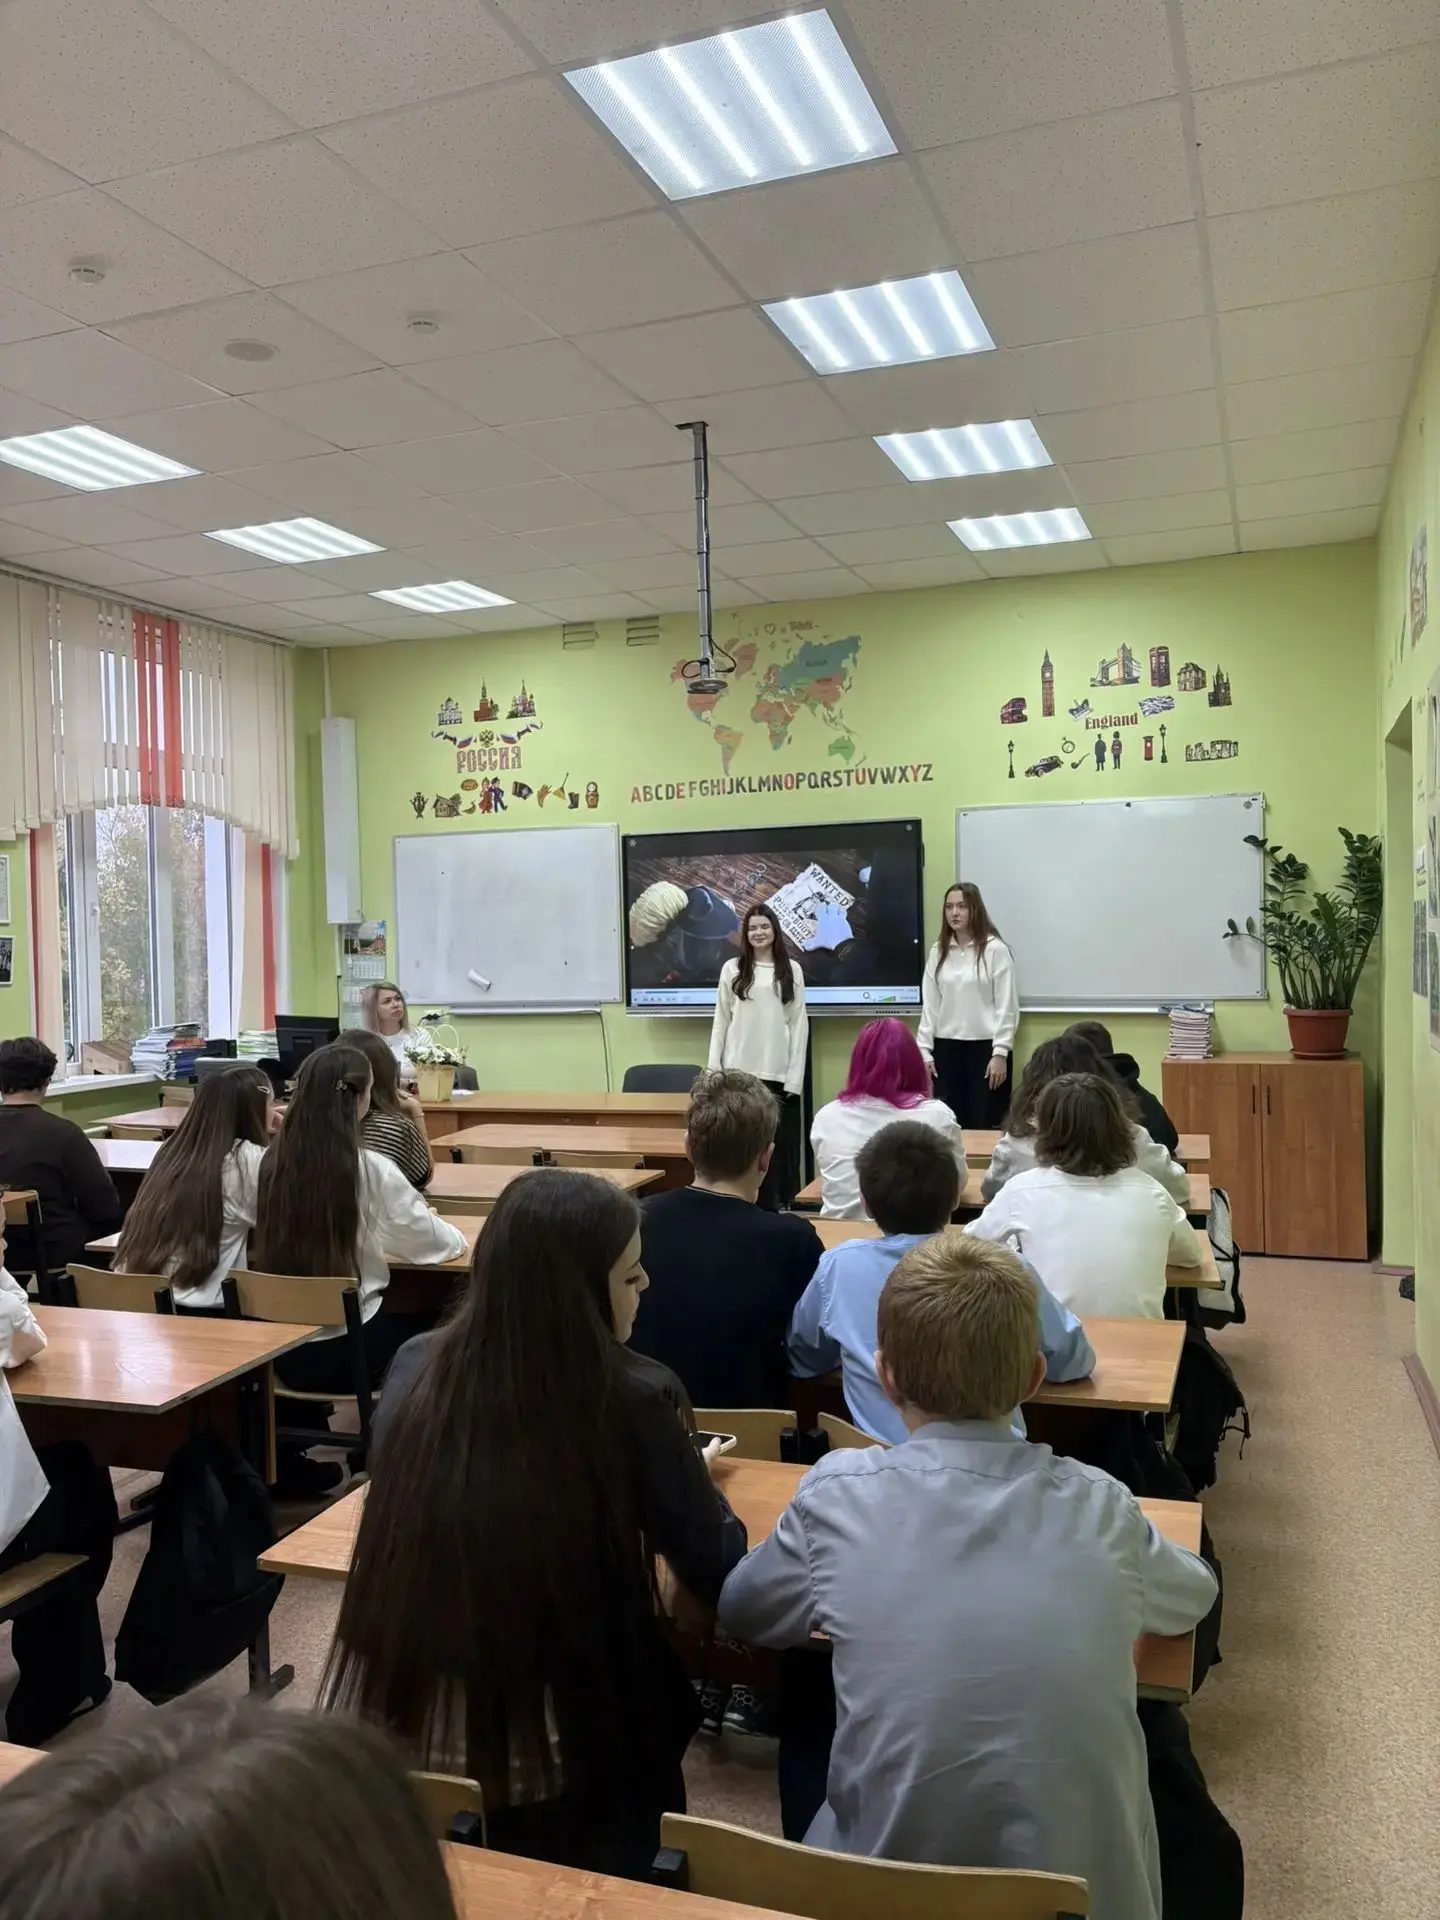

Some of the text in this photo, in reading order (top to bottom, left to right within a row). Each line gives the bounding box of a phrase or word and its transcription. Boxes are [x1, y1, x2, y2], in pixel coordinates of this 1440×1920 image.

[1085, 712, 1138, 730] England
[456, 746, 522, 774] РОССИЯ
[809, 867, 849, 907] WANTED
